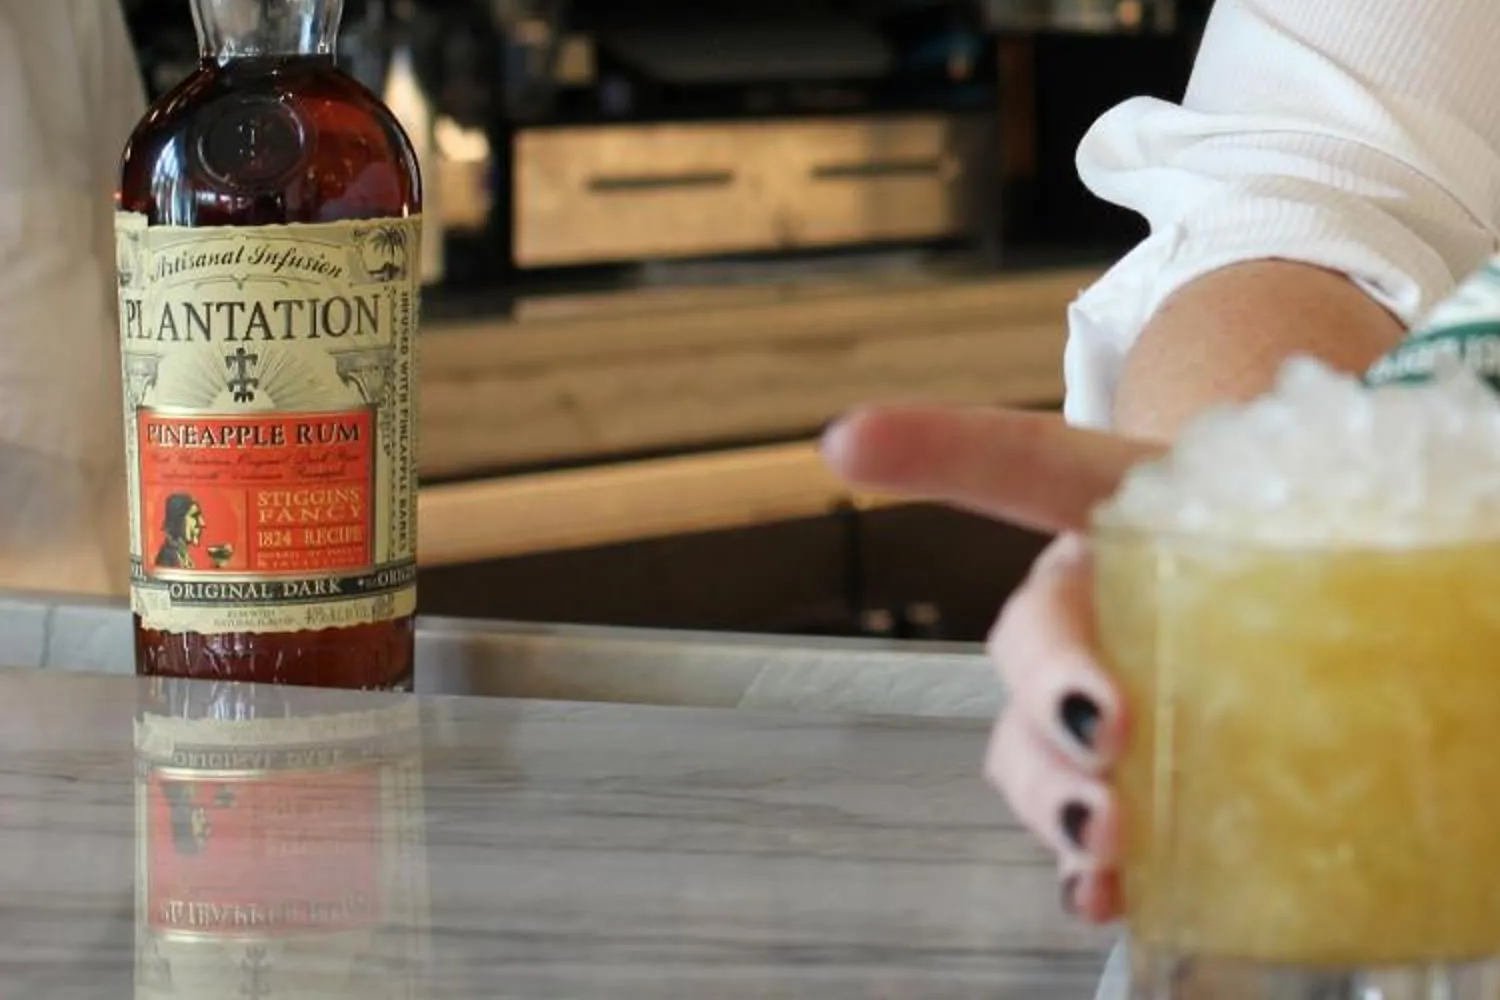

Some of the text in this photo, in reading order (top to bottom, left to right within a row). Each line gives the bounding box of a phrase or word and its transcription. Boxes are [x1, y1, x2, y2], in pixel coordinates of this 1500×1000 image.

[152, 244, 343, 281] Artisanal Infusion
[126, 293, 380, 342] PLANTATION
[147, 422, 360, 448] PINEAPPLE RUM
[258, 503, 361, 523] FANCY
[170, 582, 273, 600] ORIGINAL
[283, 575, 343, 598] DARK
